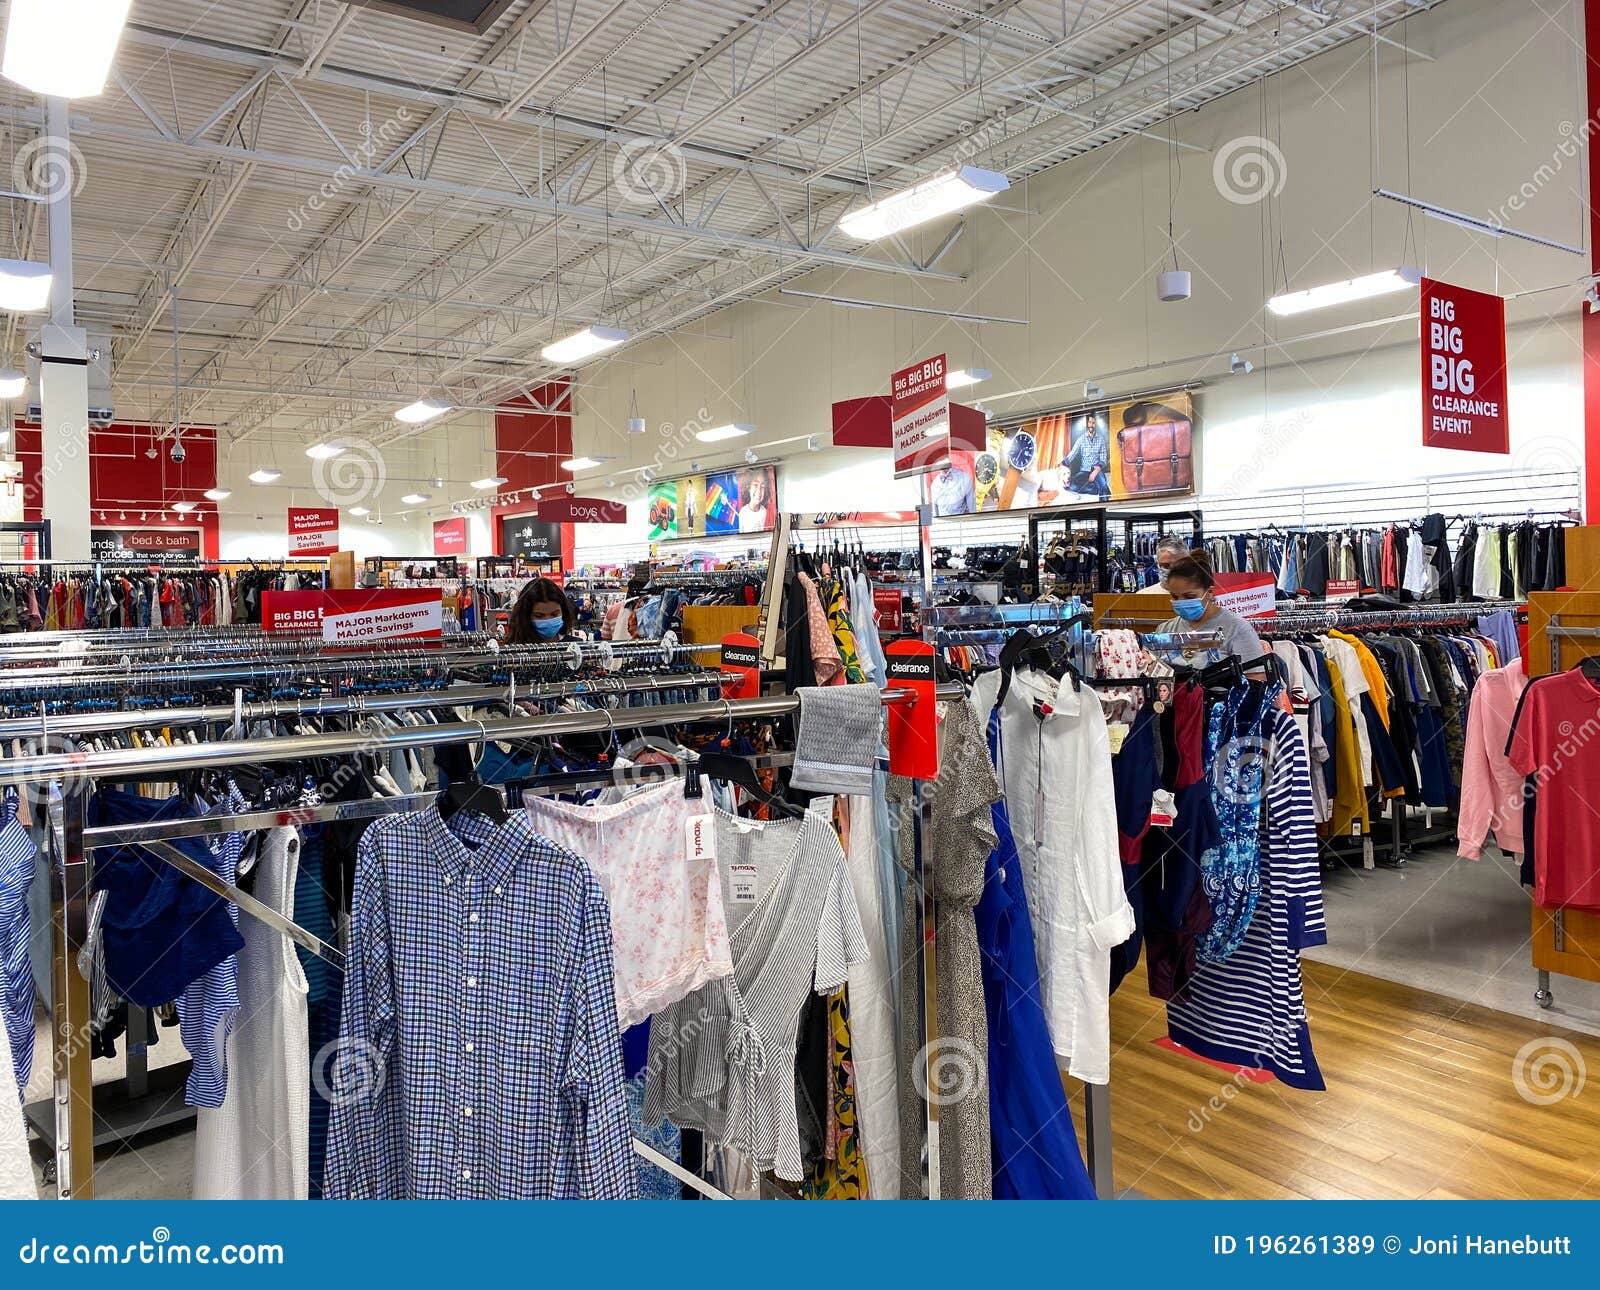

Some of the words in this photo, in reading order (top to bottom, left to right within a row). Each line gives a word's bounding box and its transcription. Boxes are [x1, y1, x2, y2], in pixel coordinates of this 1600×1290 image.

[1430, 297, 1455, 322] BIG
[1430, 322, 1463, 354] BIG
[895, 381, 907, 391] BIG
[908, 370, 922, 386] BIG
[923, 359, 943, 380] BIG
[1431, 353, 1475, 395] BIG
[895, 385, 926, 400] CLEARANCE
[924, 376, 943, 390] EVENT
[1432, 394, 1498, 417] CLEARANCE
[895, 421, 914, 439] MAJOR
[914, 406, 947, 429] Markdowns
[1432, 415, 1472, 434] EVENT!
[900, 433, 920, 449] MAJOR
[293, 513, 320, 522] MAJOR
[570, 504, 598, 518] boys
[294, 520, 334, 529] Markdowns
[131, 536, 152, 545] bed
[155, 536, 163, 545] &
[166, 536, 190, 545] bath
[100, 549, 134, 559] prices
[1236, 592, 1268, 603] Markdowns
[274, 613, 291, 621] BIG
[293, 610, 315, 620] BIG
[1237, 604, 1260, 613] Savings
[335, 616, 372, 629] MAJOR
[374, 608, 430, 624] Markdowns
[336, 627, 374, 639] MAJOR
[377, 621, 414, 633] Savings
[724, 651, 756, 662] clearance
[891, 662, 930, 674] clearance
